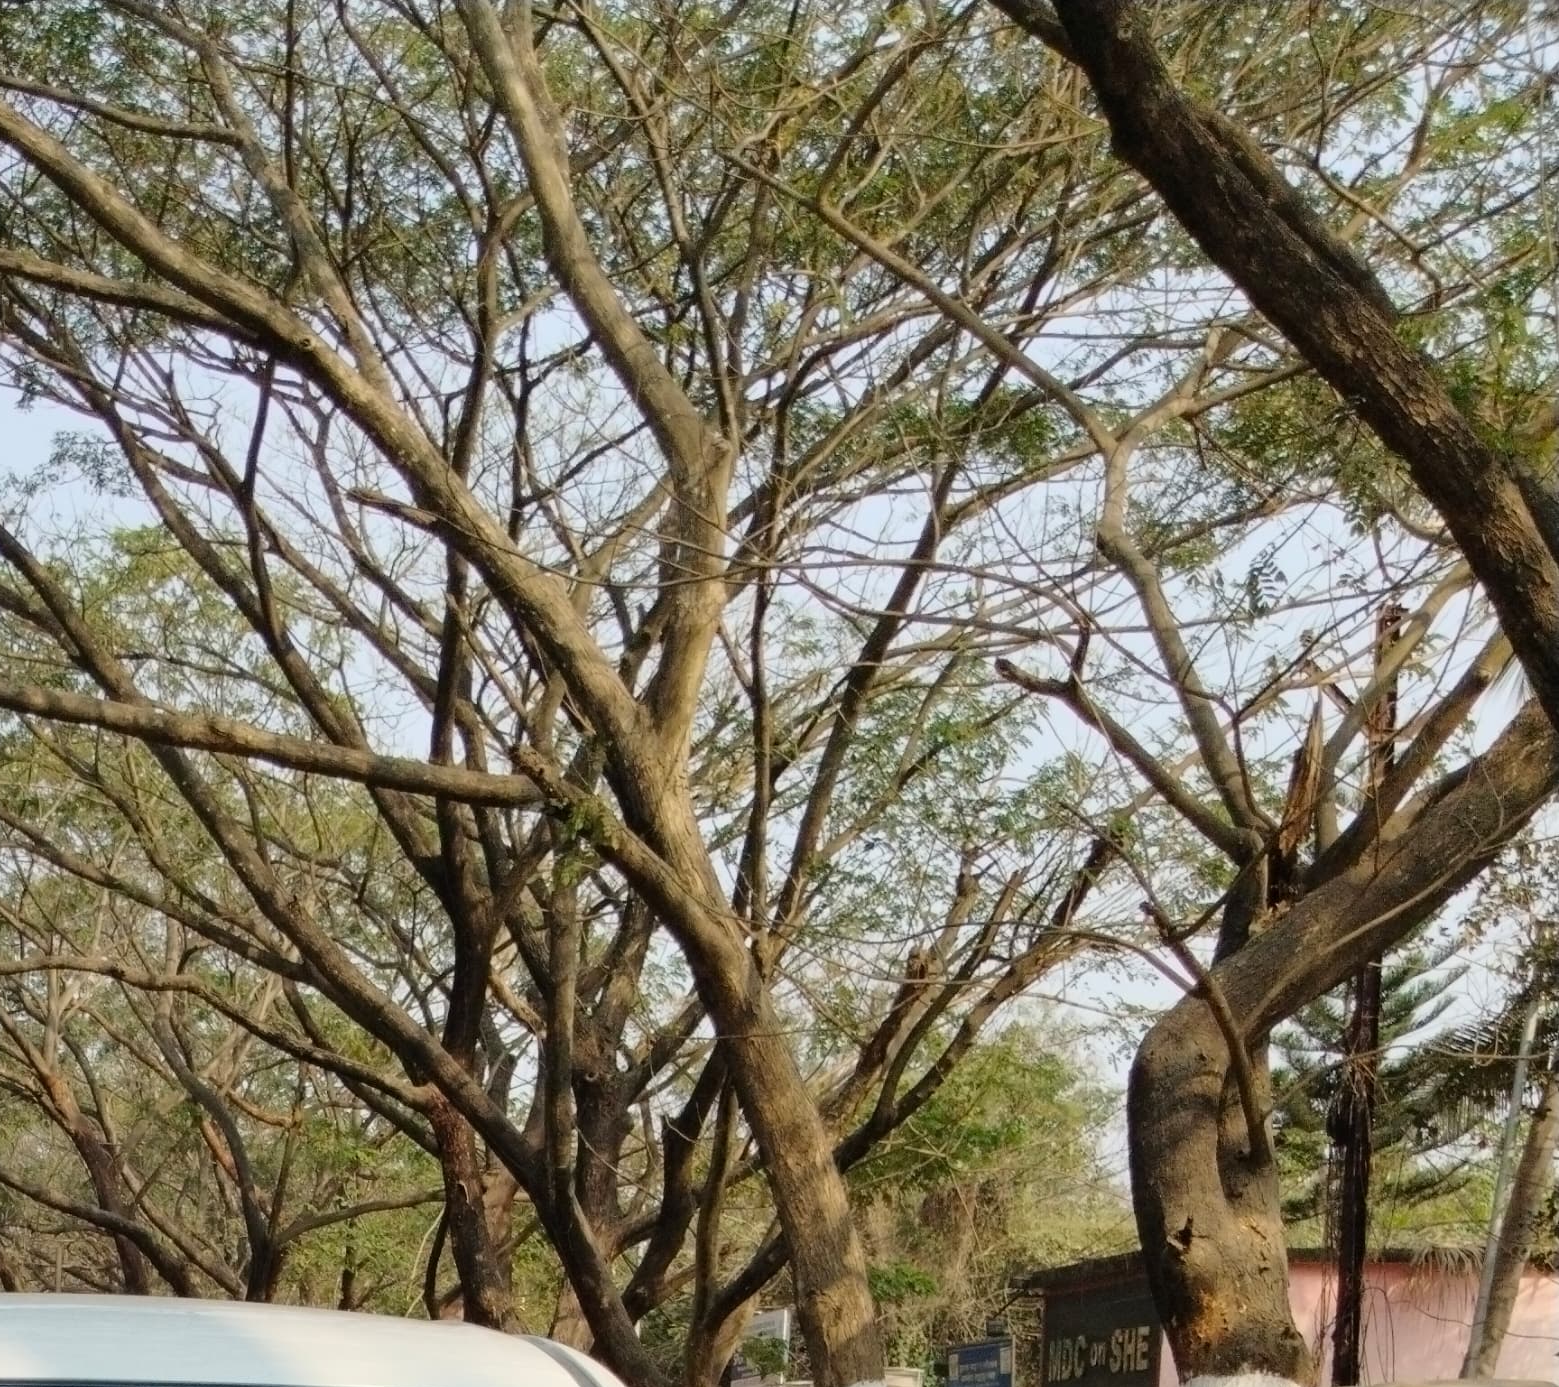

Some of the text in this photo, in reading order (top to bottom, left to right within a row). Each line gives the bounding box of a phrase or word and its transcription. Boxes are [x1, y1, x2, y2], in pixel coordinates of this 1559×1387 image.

[1048, 1335, 1088, 1382] MDC
[1089, 1342, 1106, 1367] on
[1109, 1326, 1150, 1374] SHE
